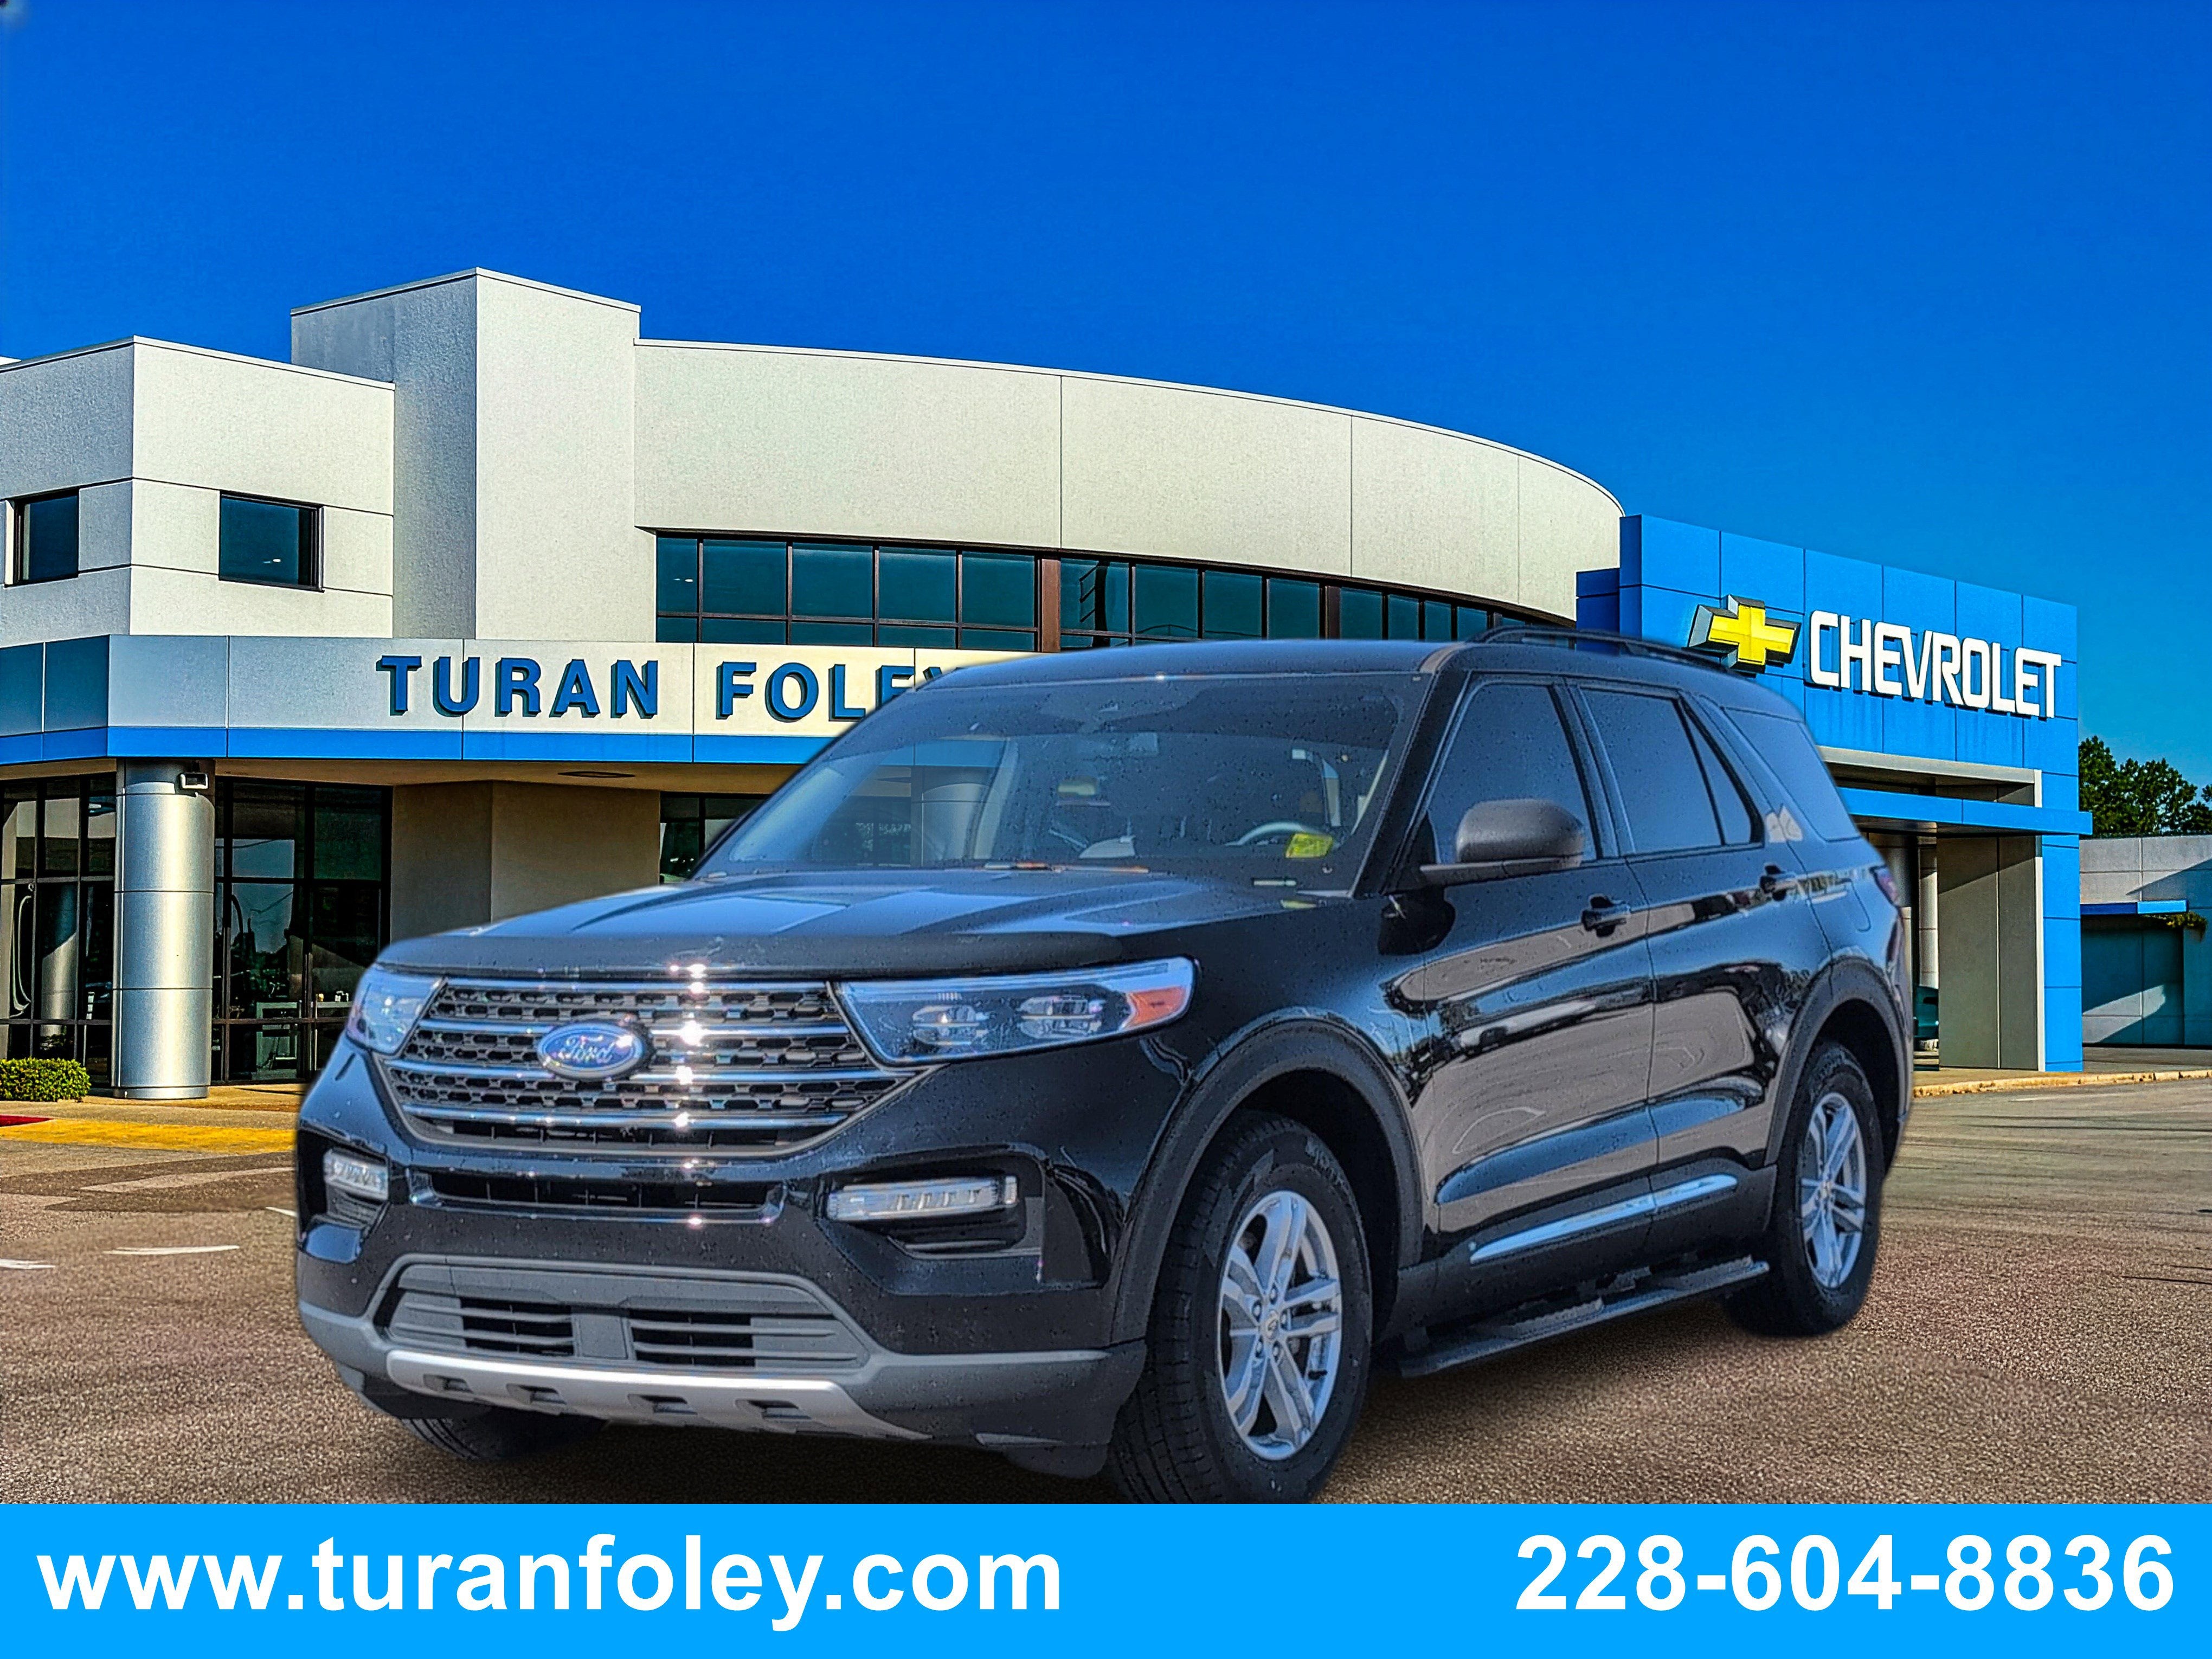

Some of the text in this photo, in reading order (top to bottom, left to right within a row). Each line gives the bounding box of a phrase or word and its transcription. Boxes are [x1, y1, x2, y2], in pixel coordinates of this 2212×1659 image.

[376, 655, 965, 720] TURAN FOLE
[1809, 610, 2062, 719] CHEVROLET
[557, 1034, 616, 1063] Ford
